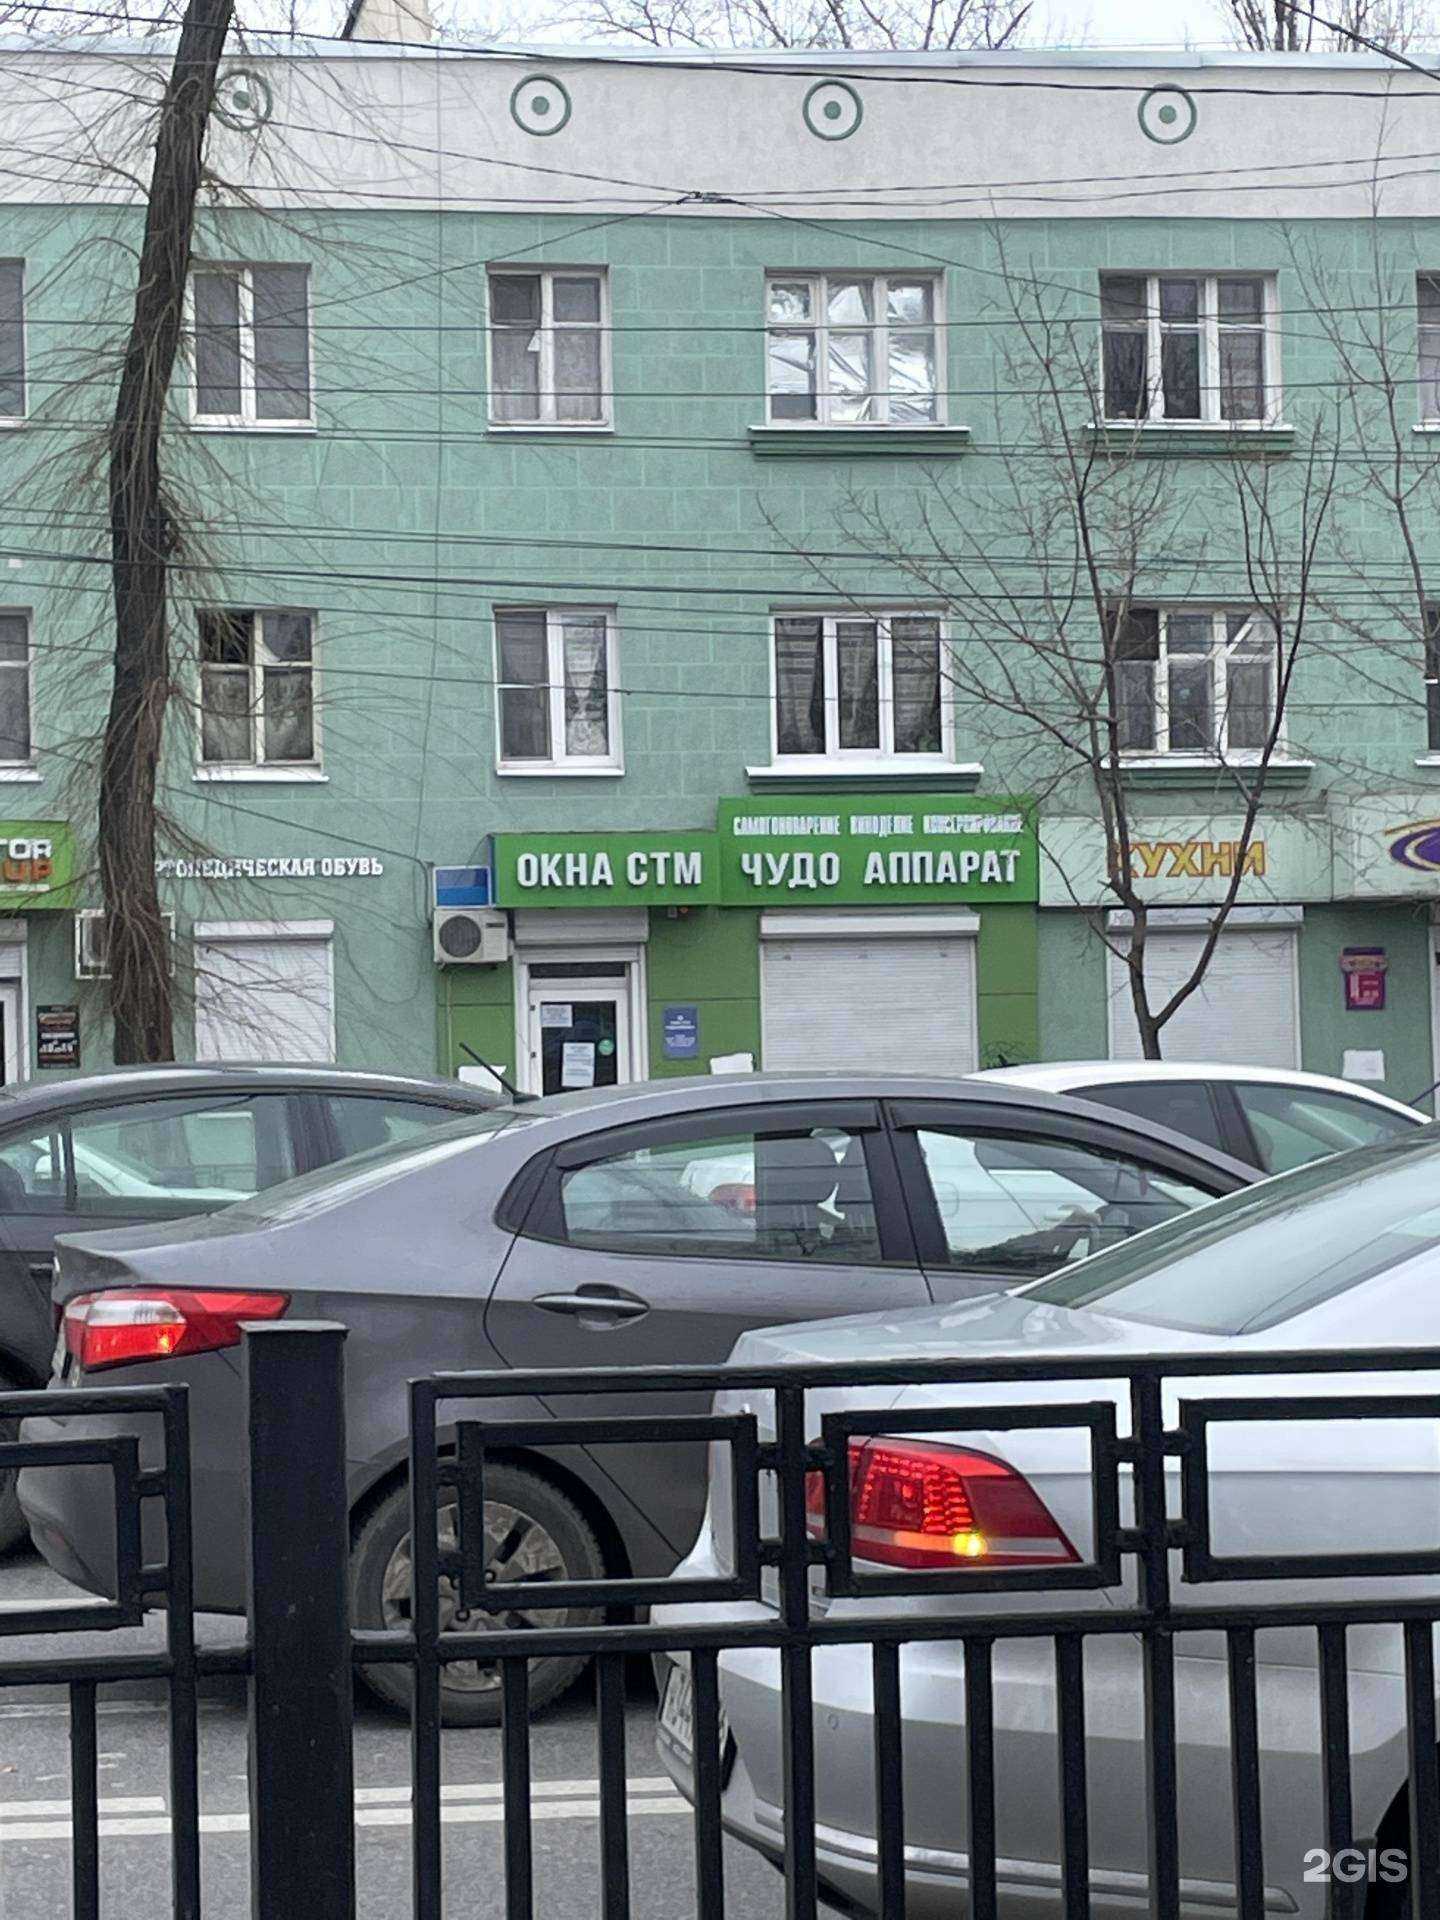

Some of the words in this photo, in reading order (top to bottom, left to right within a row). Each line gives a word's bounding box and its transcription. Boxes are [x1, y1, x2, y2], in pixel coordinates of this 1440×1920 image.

[154, 858, 315, 879] РТОПЕДИЧЕСКАЯ
[321, 857, 384, 877] ОБУВЬ
[516, 852, 614, 887] ОКНА
[626, 851, 702, 886] СТМ
[741, 852, 841, 889] ЧУДО
[863, 850, 1021, 885] АППАРАТ
